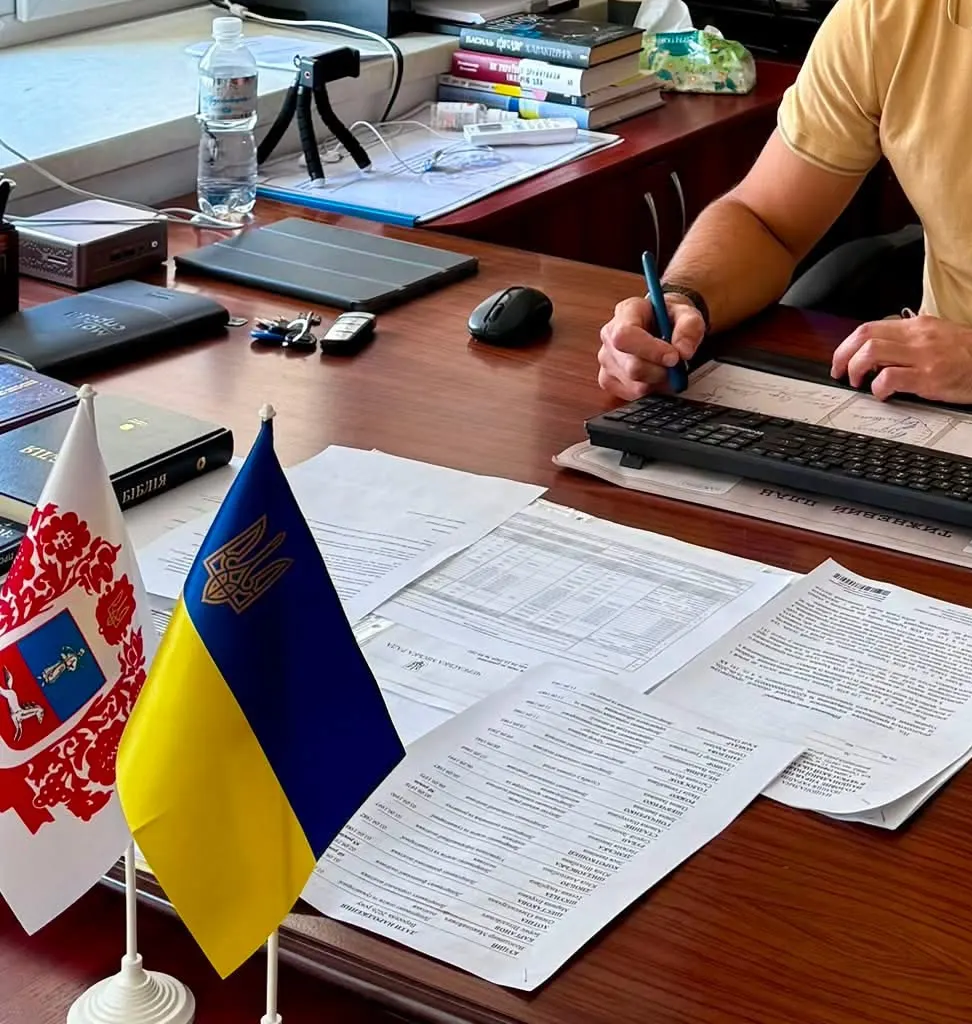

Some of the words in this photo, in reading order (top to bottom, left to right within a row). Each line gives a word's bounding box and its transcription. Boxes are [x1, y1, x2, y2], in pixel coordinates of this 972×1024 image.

[465, 35, 494, 47] ВАСИЛЬ
[121, 472, 168, 504] БІБЛІЯ
[759, 488, 818, 507] ПЛАН
[831, 504, 953, 538] ТИЖНЕВИЙ
